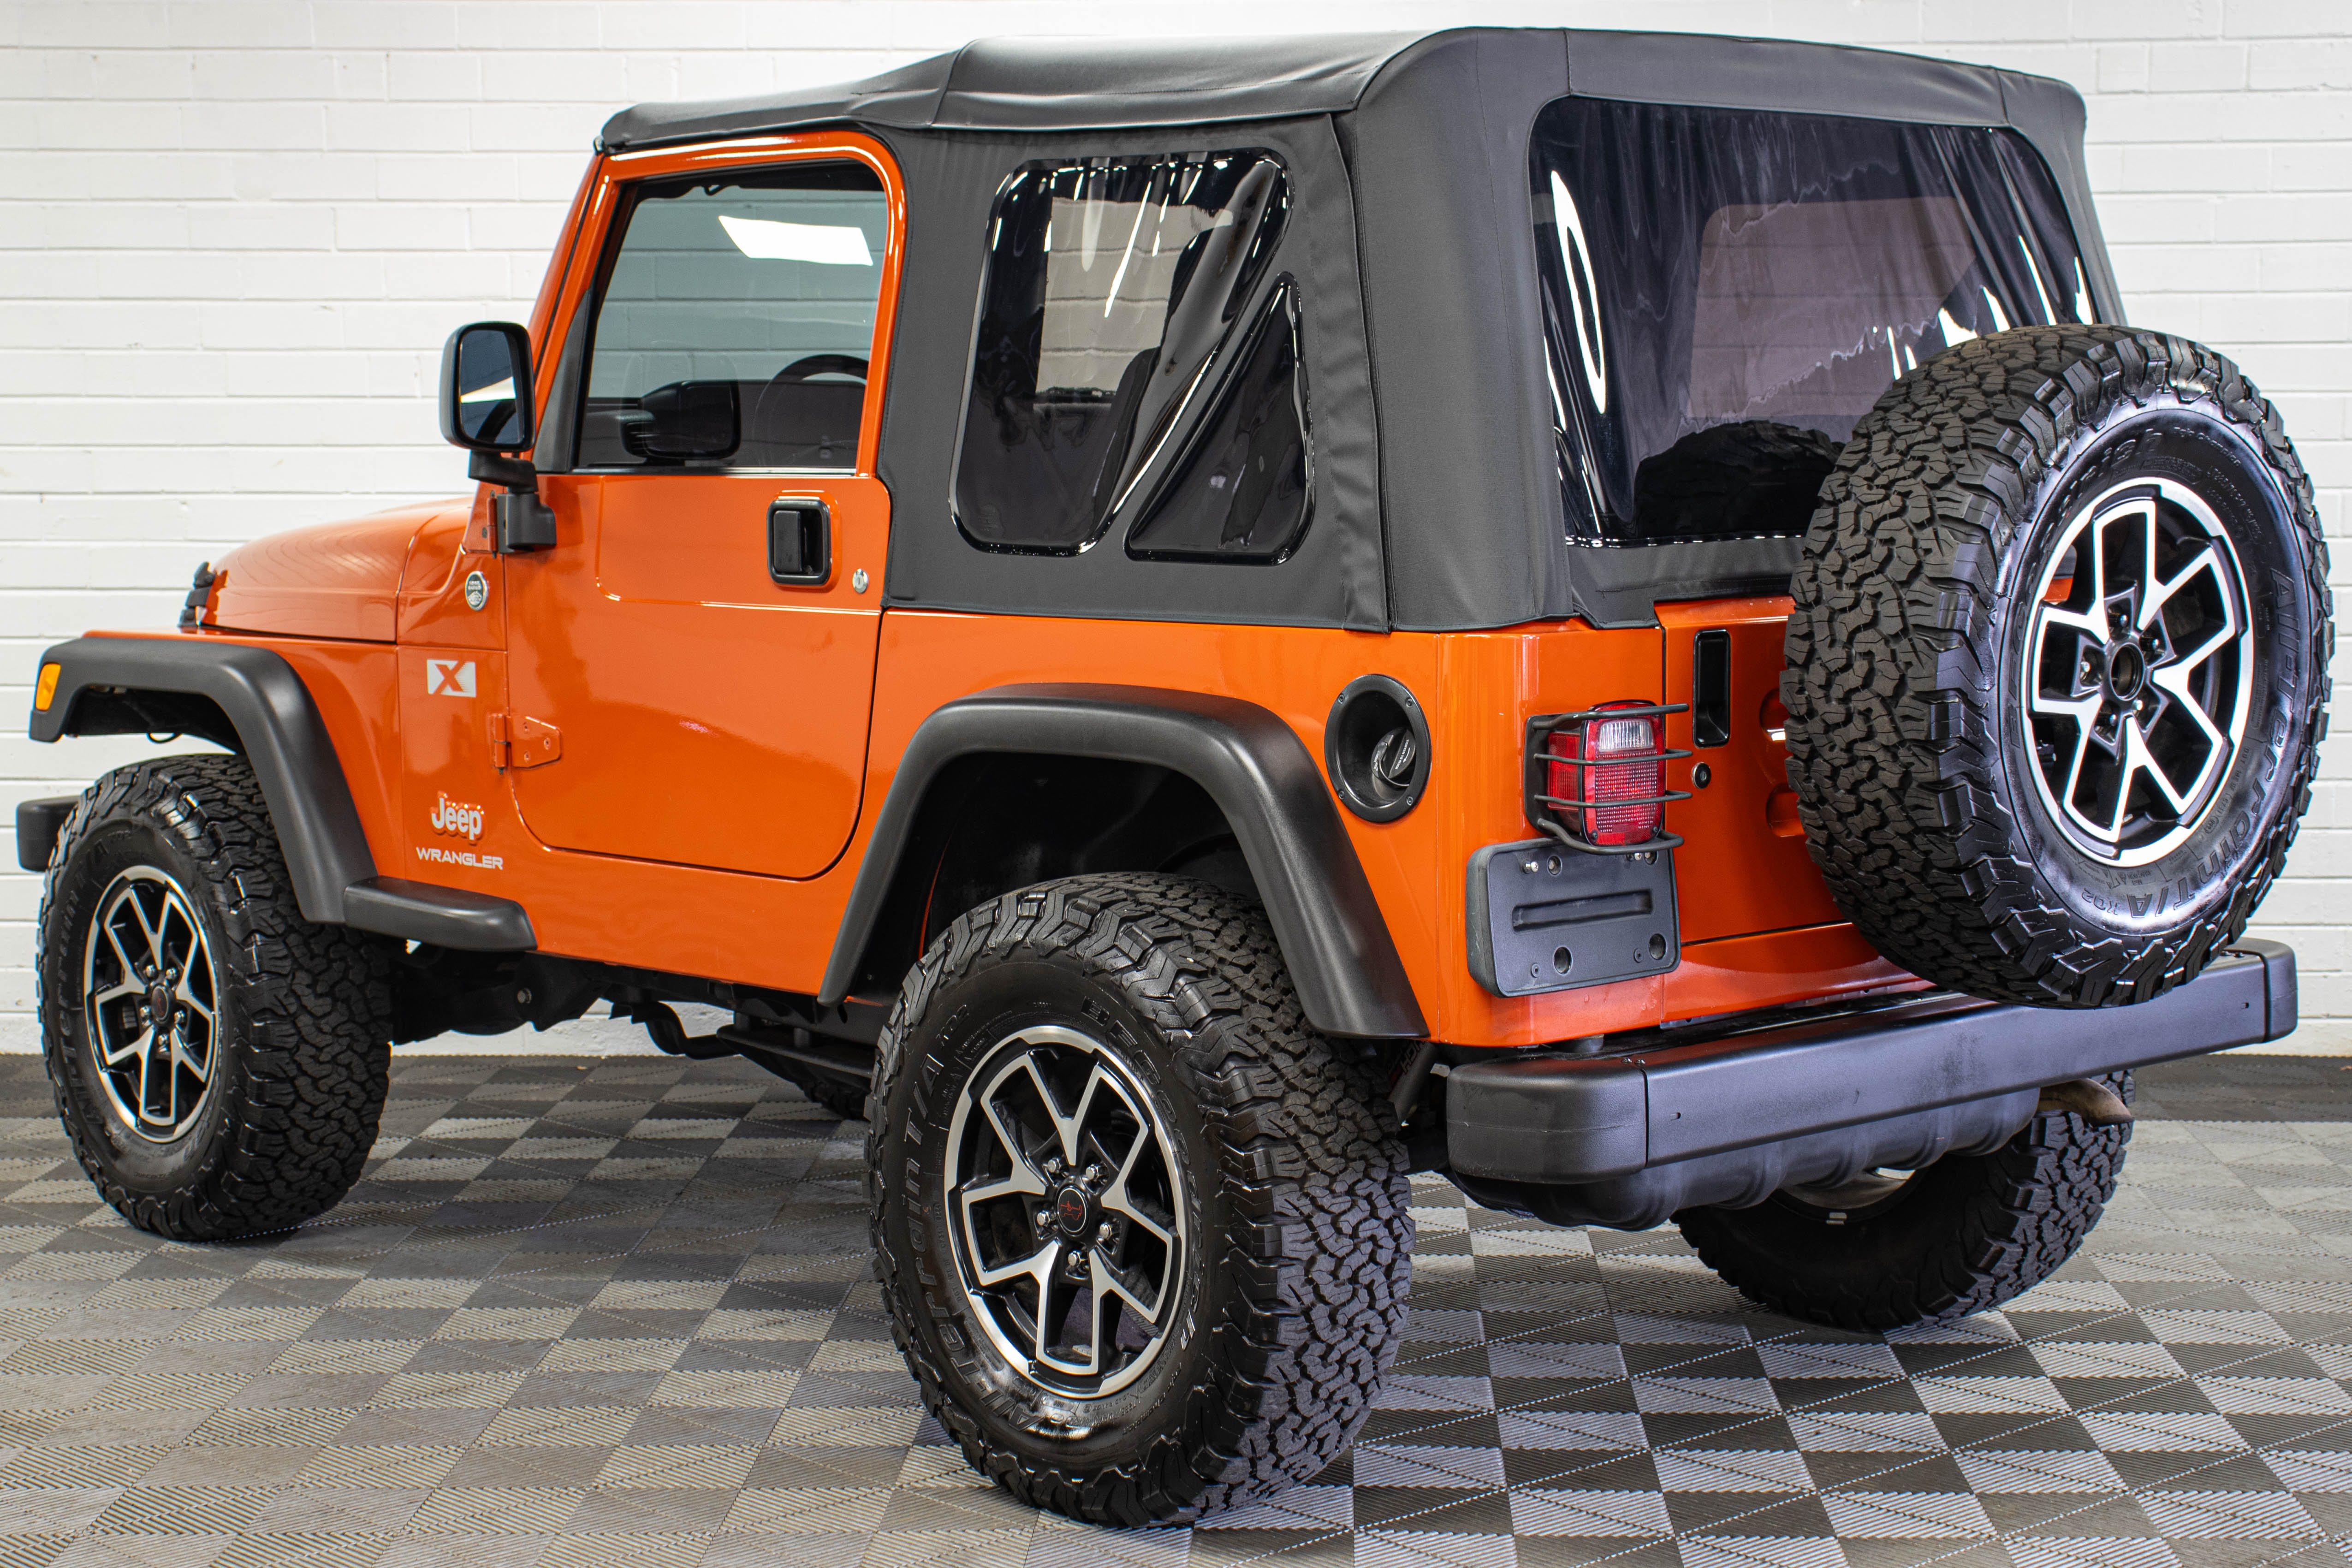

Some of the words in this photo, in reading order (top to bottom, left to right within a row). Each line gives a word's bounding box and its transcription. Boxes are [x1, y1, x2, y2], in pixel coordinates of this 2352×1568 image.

[2197, 567, 2299, 885] All-Terrain
[416, 847, 503, 870] WRANGLER
[432, 797, 481, 840] Jeep
[2126, 877, 2196, 919] T/A
[903, 1053, 944, 1145] T/A
[1081, 996, 1202, 1351] BFGoodrich
[901, 1158, 1042, 1430] All-Terrain
